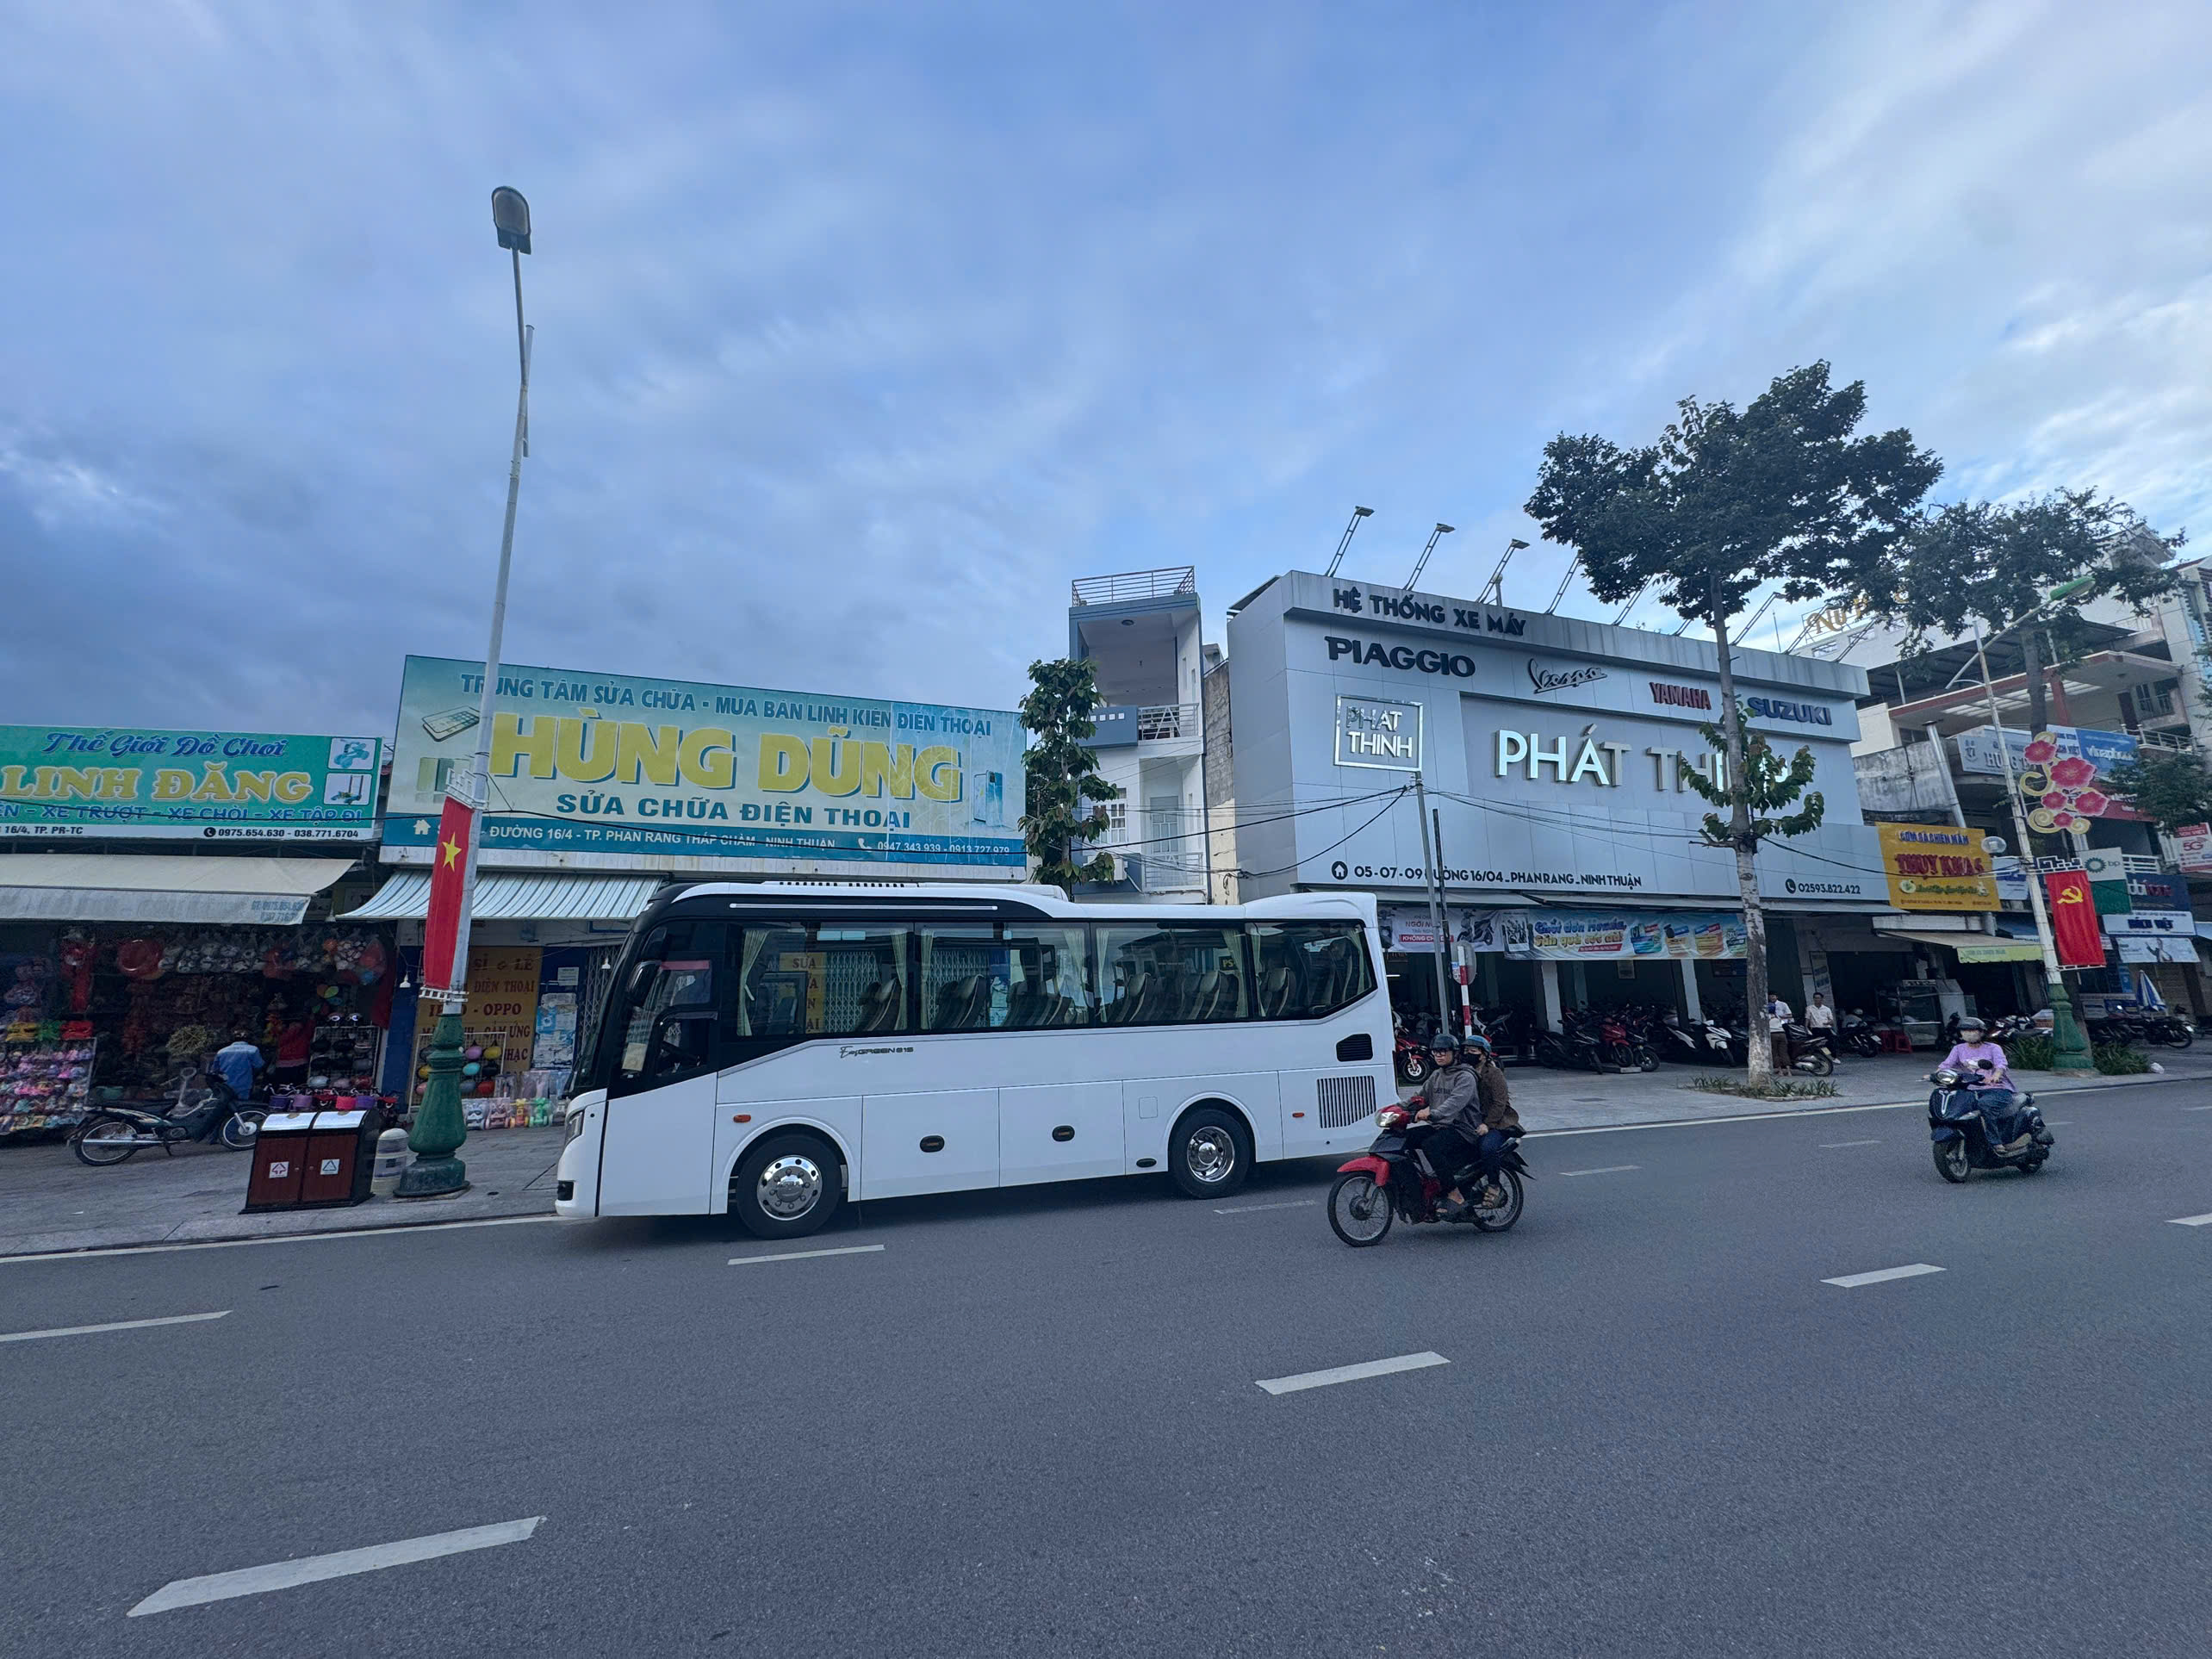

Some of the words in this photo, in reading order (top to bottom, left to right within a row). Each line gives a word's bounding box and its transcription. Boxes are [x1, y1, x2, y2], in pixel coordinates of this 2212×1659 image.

[1333, 587, 1362, 612] HỆ
[1369, 594, 1445, 623] THỐNG
[1453, 608, 1480, 629] XE
[1487, 612, 1526, 637] MÁY
[1324, 636, 1476, 677] PIAGGIO
[1527, 658, 1607, 694] Vespa
[1649, 681, 1712, 710] YAMAHA
[541, 680, 587, 702] TÂM
[593, 680, 635, 706] SỬA
[641, 688, 696, 711] CHỮA
[715, 696, 758, 717] MUA
[763, 699, 803, 721] BÁN
[807, 704, 848, 725] LINH
[853, 707, 891, 730] KIỆN
[898, 712, 935, 734] ĐIỆN
[940, 716, 991, 739] THOẠI
[1747, 696, 1832, 725] SUZUKI
[41, 731, 107, 753] Thế
[109, 732, 166, 757] Giới
[172, 732, 221, 757] Đồ
[222, 737, 291, 758] Chơi
[488, 707, 736, 790] HÙNG
[757, 725, 963, 803] DŨNG
[1495, 723, 1632, 786] PHÁT
[0, 764, 143, 801] LINH
[151, 761, 314, 804] ĐĂNG
[42, 805, 70, 819] XE
[78, 805, 147, 823] TRƯỢT
[270, 808, 296, 822] XE
[301, 806, 337, 825] TẬP
[339, 810, 363, 823] ĐI
[556, 789, 624, 816] SỬA
[637, 796, 730, 821] CHỮA
[740, 801, 812, 828] ĐIỆN
[823, 808, 910, 831] THOẠI
[34, 826, 47, 835] TP.
[52, 826, 84, 835] PR-TC
[218, 828, 285, 837] 0975.654.630
[294, 830, 359, 838] 038.771.6704
[489, 824, 543, 839] ĐƯỜNG
[547, 828, 573, 840] 16/4
[585, 830, 602, 841] TP.
[606, 830, 642, 842] PHAN
[645, 831, 681, 844] RANG
[2183, 841, 2203, 851] 5G
[1470, 870, 1503, 883] 16/04
[1510, 872, 1543, 884] PHAN
[1543, 873, 1574, 885] RANG
[1581, 874, 1606, 886] NINH
[1606, 873, 1642, 891] THUẬN
[1798, 882, 1861, 894] 02593.822.422
[503, 979, 535, 995] THOẠI
[483, 1003, 522, 1016] OPPO
[509, 1022, 531, 1038] ỨNG
